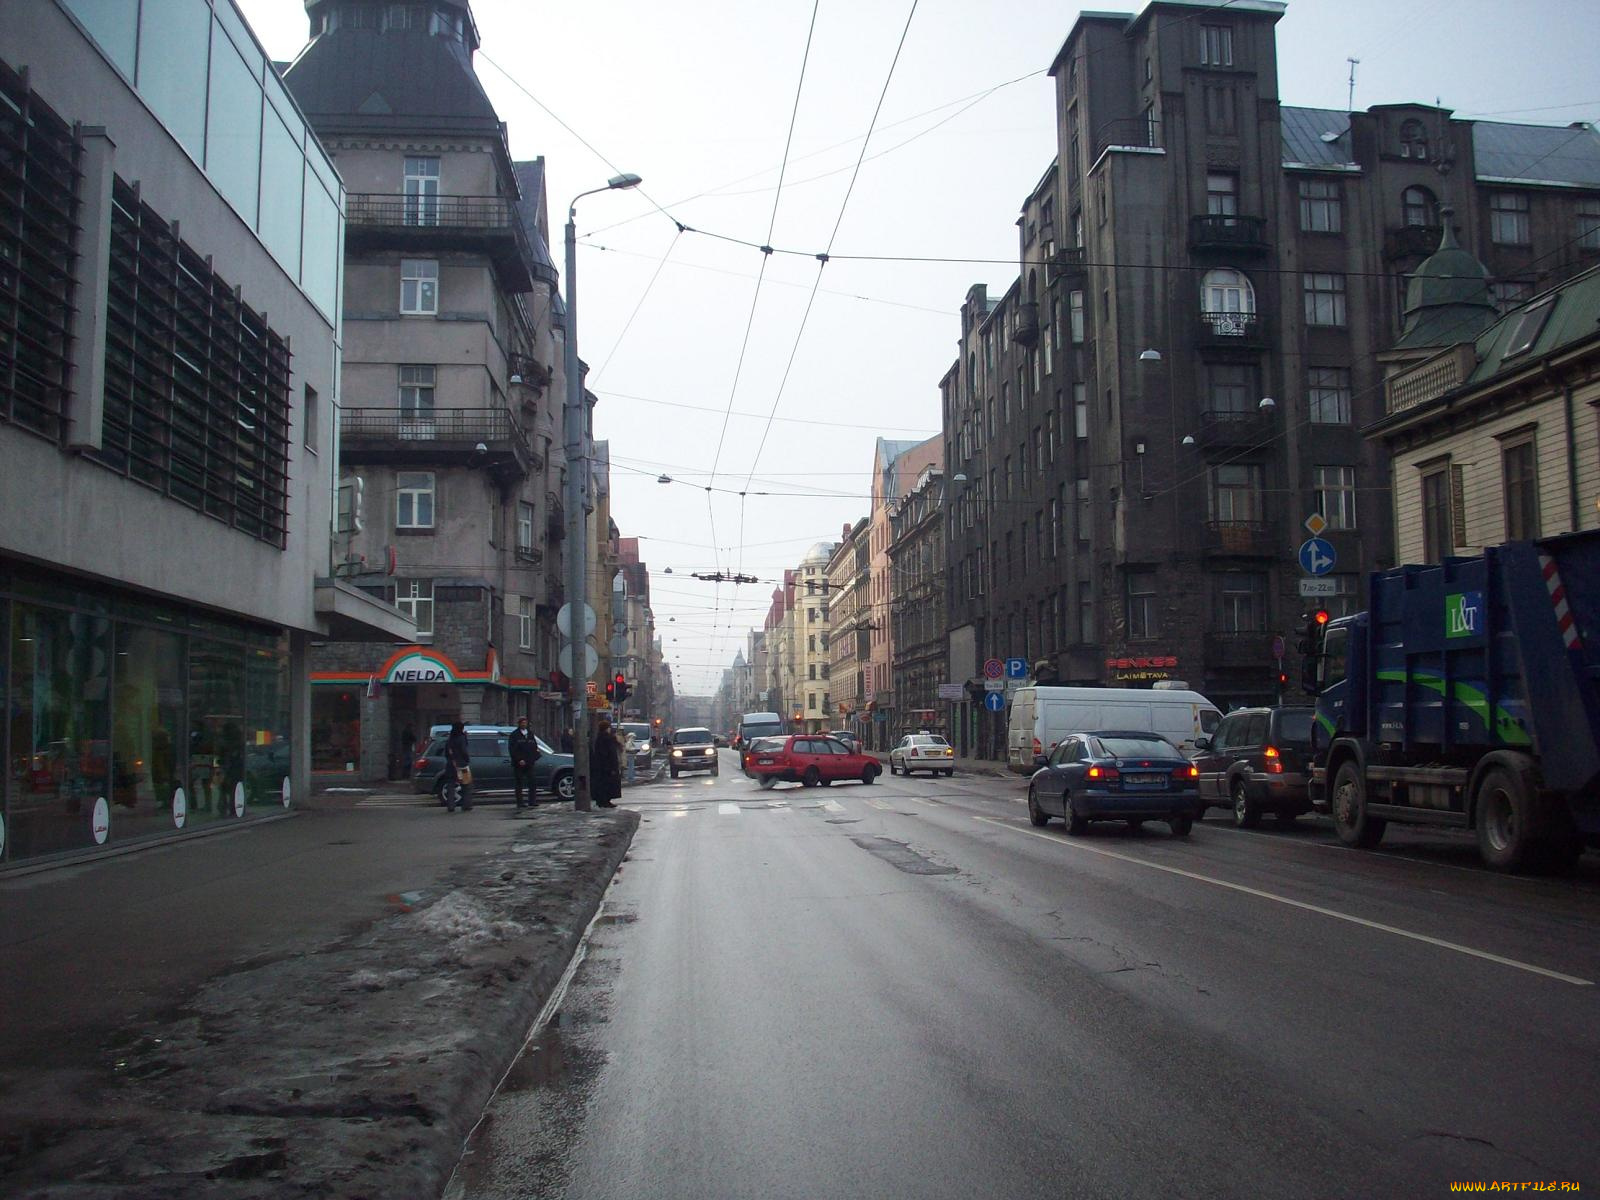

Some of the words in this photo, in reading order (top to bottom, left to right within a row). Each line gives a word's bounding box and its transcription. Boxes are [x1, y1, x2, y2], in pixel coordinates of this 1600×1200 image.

[1451, 596, 1477, 632] L&T
[394, 670, 445, 681] NELDA
[1010, 661, 1022, 676] P
